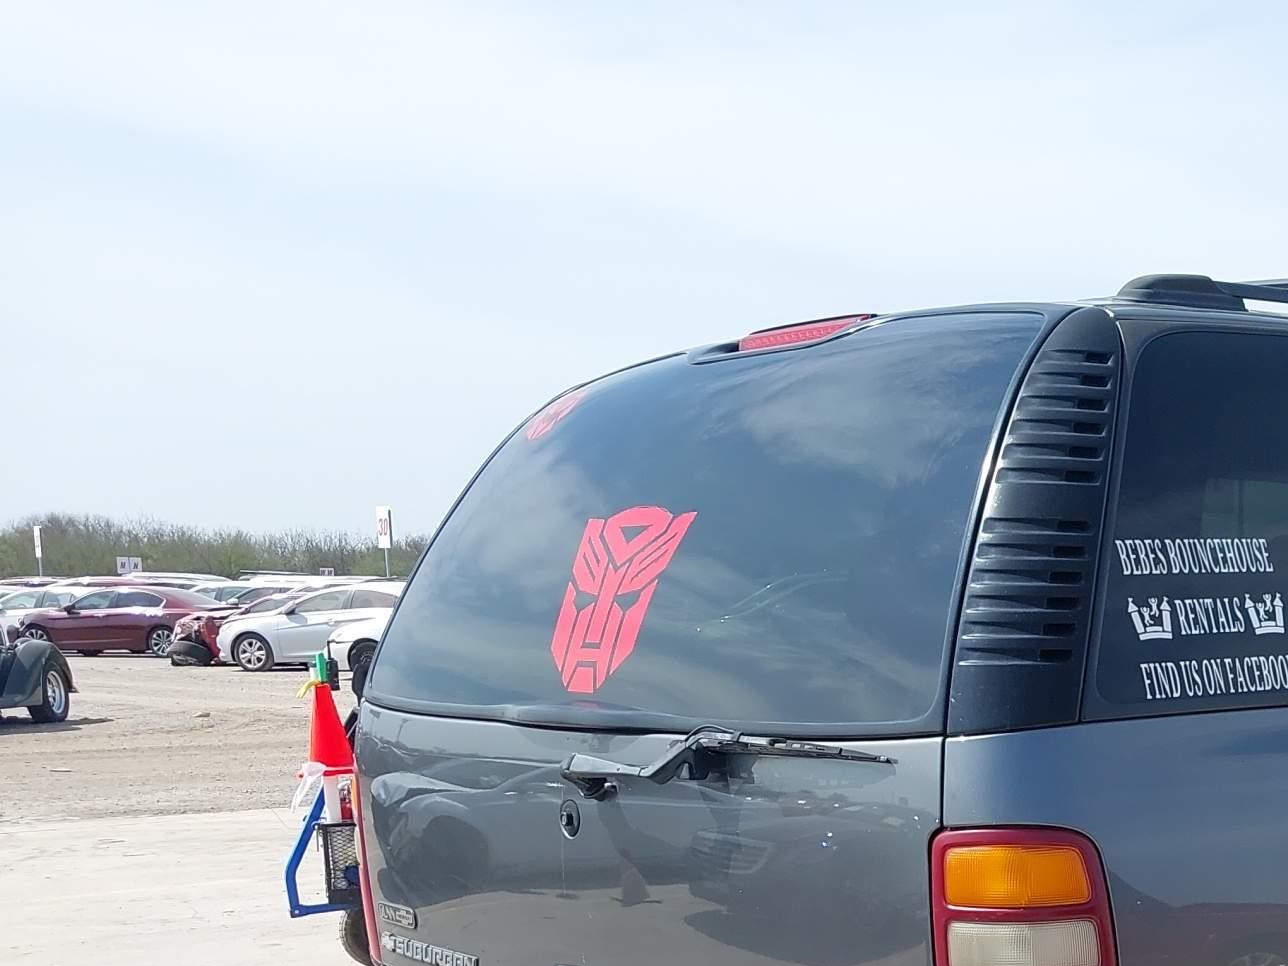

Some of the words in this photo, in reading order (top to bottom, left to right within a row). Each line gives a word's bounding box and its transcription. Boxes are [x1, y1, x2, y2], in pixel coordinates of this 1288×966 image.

[378, 517, 389, 537] 30
[1115, 538, 1168, 576] BEBES
[1164, 538, 1273, 574] BOUNCEHOUSE
[1174, 598, 1245, 635] RENTALS
[1140, 662, 1182, 700] FIND
[1180, 659, 1203, 697] US
[1202, 657, 1227, 696] ON
